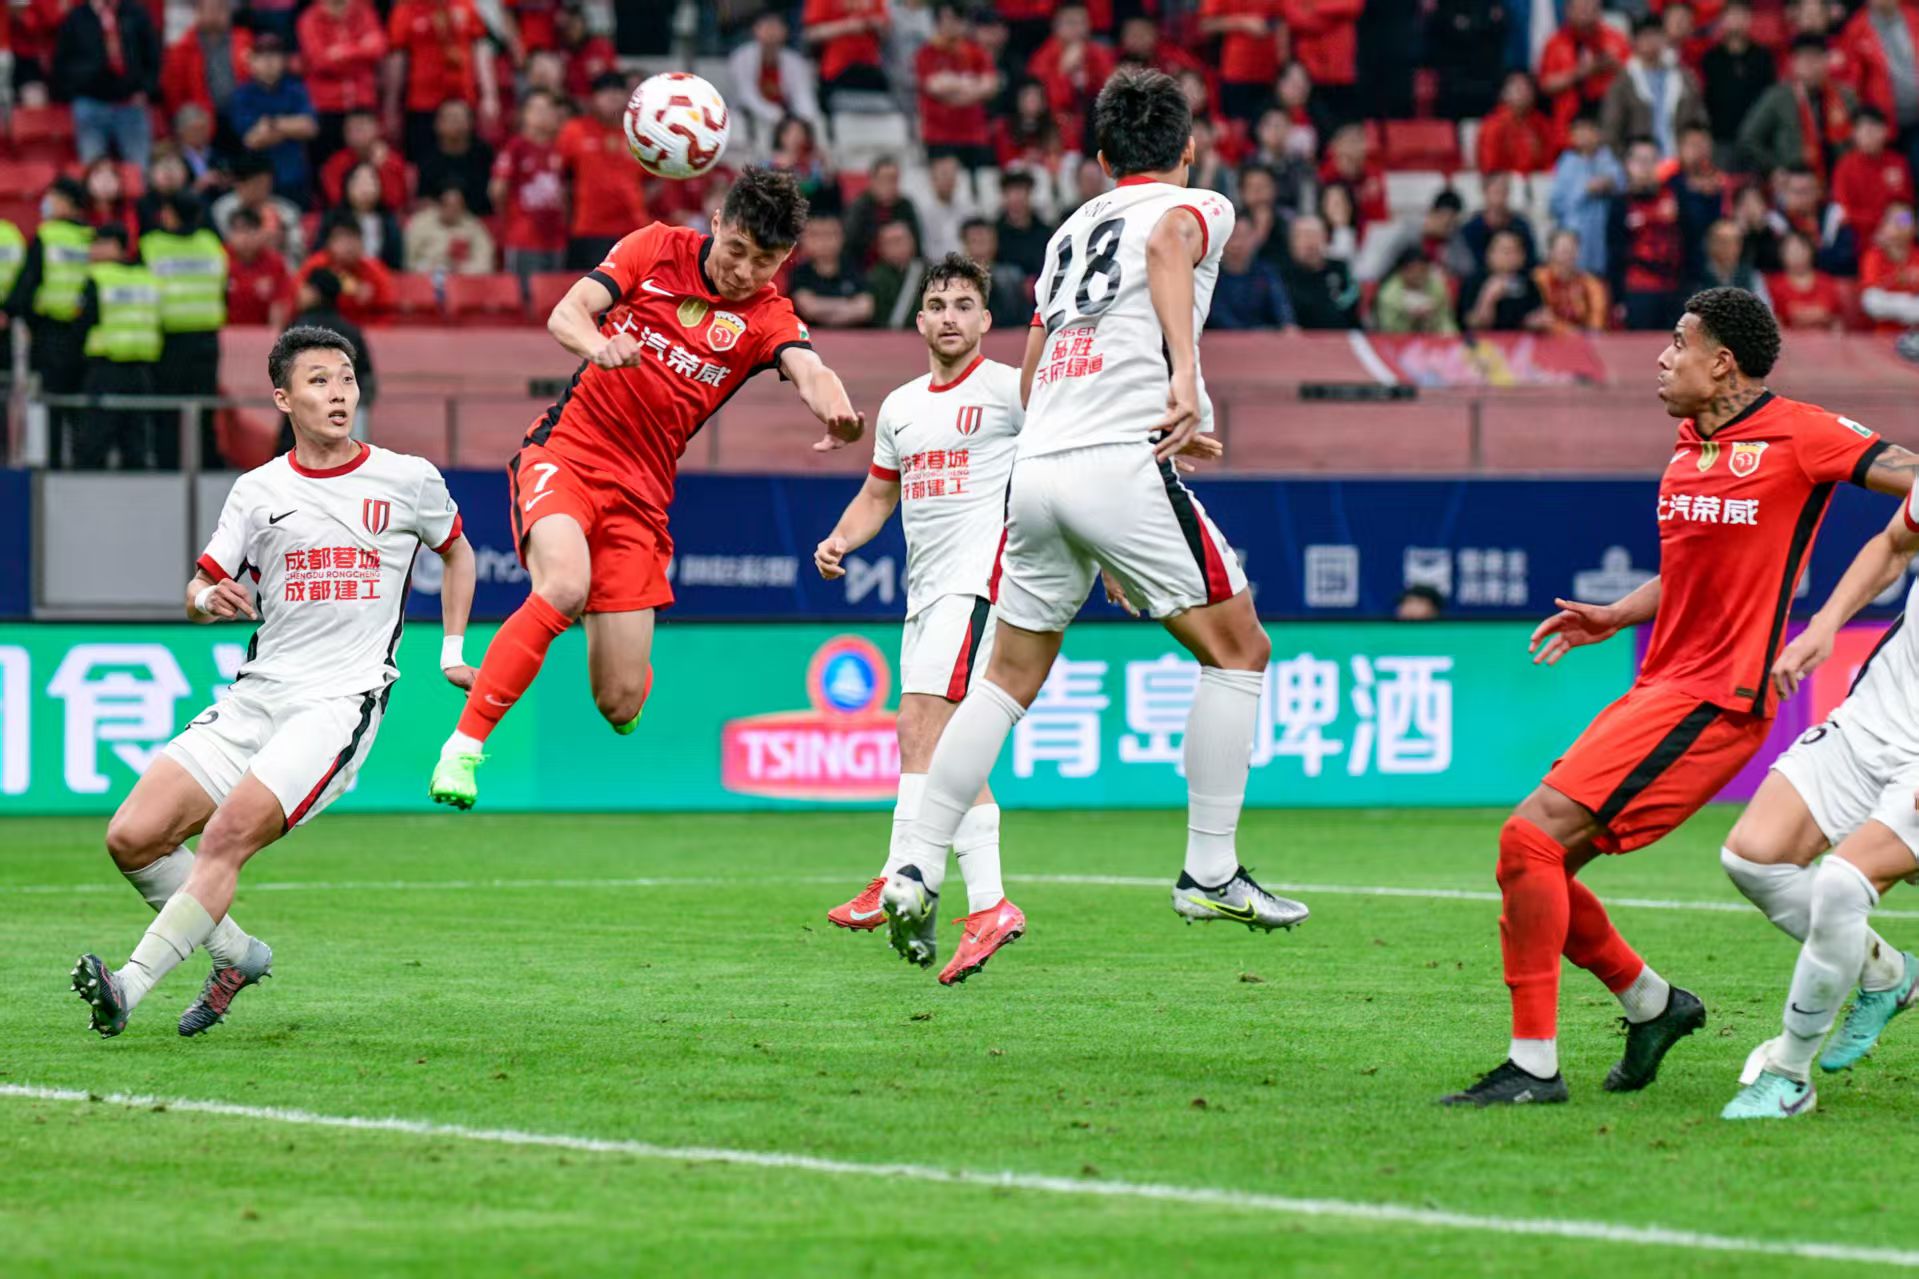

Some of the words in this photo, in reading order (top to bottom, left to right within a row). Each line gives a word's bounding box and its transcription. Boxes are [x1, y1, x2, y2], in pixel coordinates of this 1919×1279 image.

[1046, 217, 1126, 337] 18
[1051, 337, 1095, 361] 品胜
[533, 462, 559, 493] 7
[284, 546, 381, 571] 成都蓉城
[284, 571, 324, 581] CHENGDU
[326, 570, 381, 579] RONGCHENG
[284, 579, 381, 602] 成都建工
